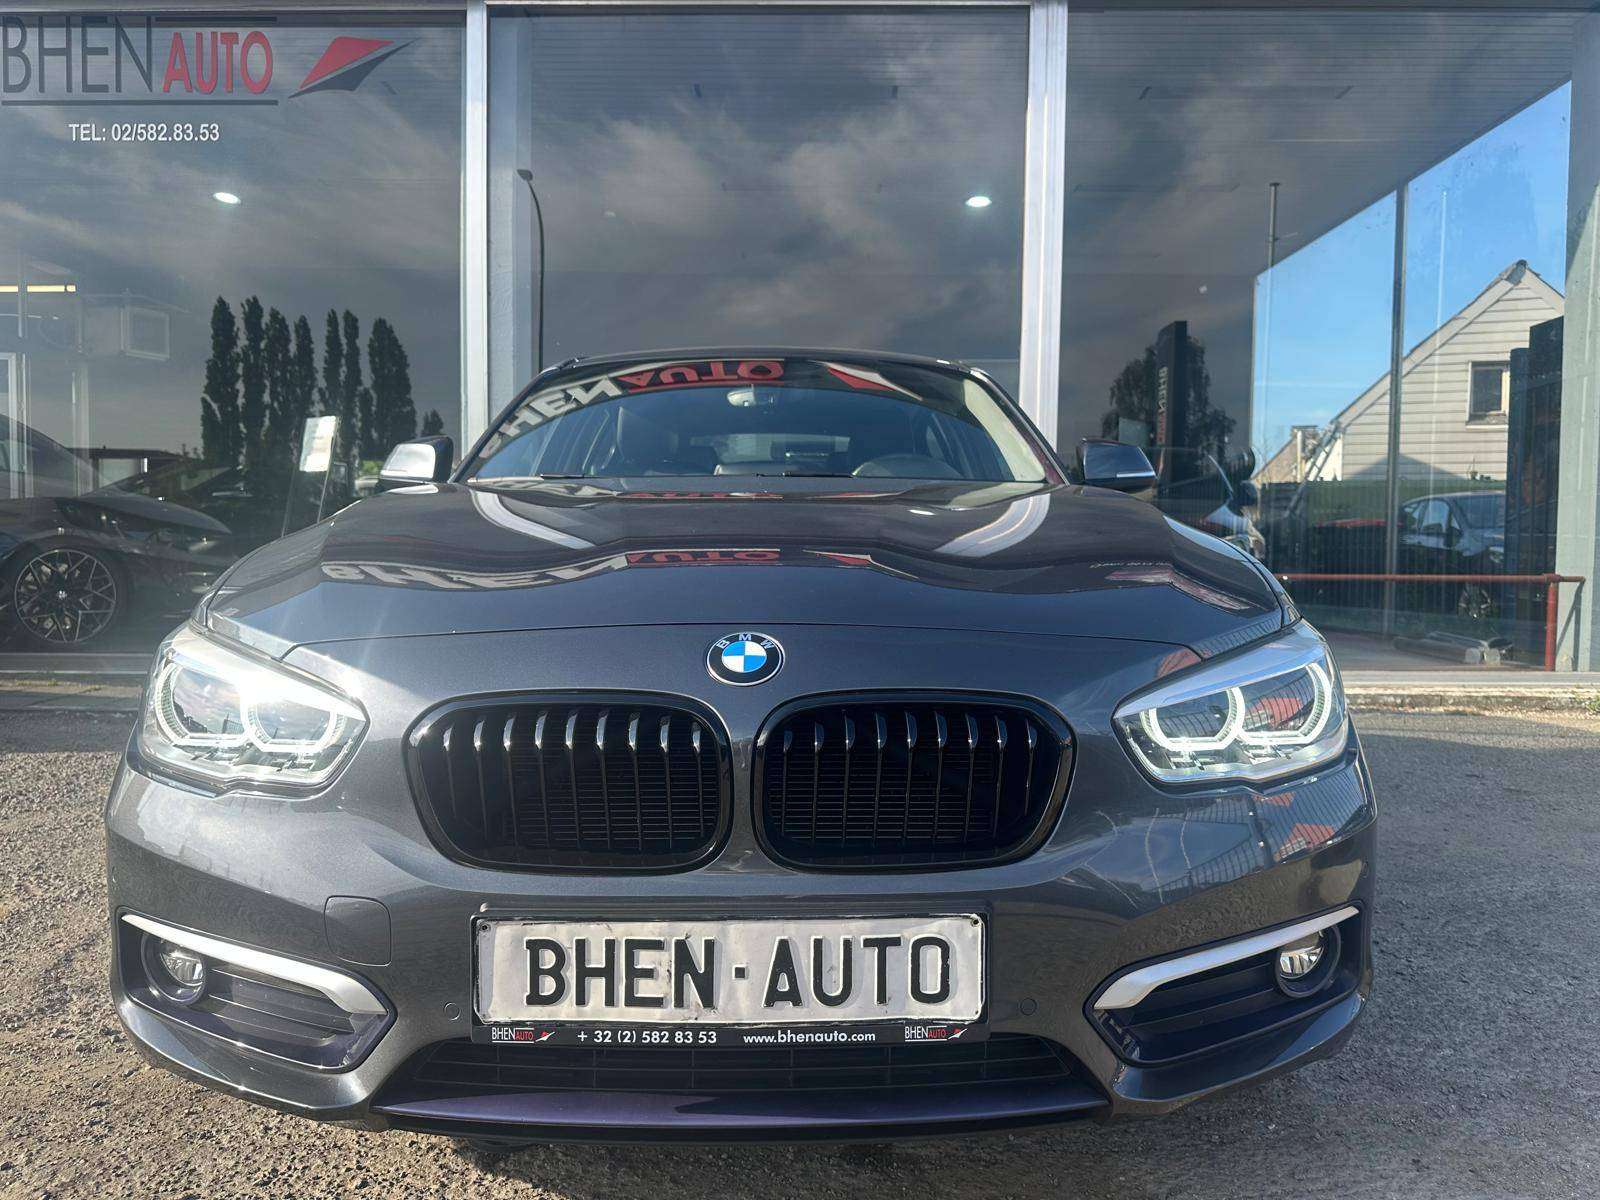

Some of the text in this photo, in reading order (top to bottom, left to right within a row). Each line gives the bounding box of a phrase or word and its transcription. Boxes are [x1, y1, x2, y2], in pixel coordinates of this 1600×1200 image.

[2, 15, 274, 94] BHEN AUTO
[68, 123, 220, 141] TEL: 02/582.83.53
[716, 632, 774, 649] BMW
[523, 936, 716, 1009] BHEN
[763, 936, 951, 1008] AUTO
[593, 1030, 612, 1043] 32
[617, 1030, 637, 1043] (2)
[641, 1030, 670, 1043] 582
[674, 1030, 693, 1043] 83
[698, 1030, 717, 1043] 53
[743, 1030, 876, 1043] www.bhenauto.com
